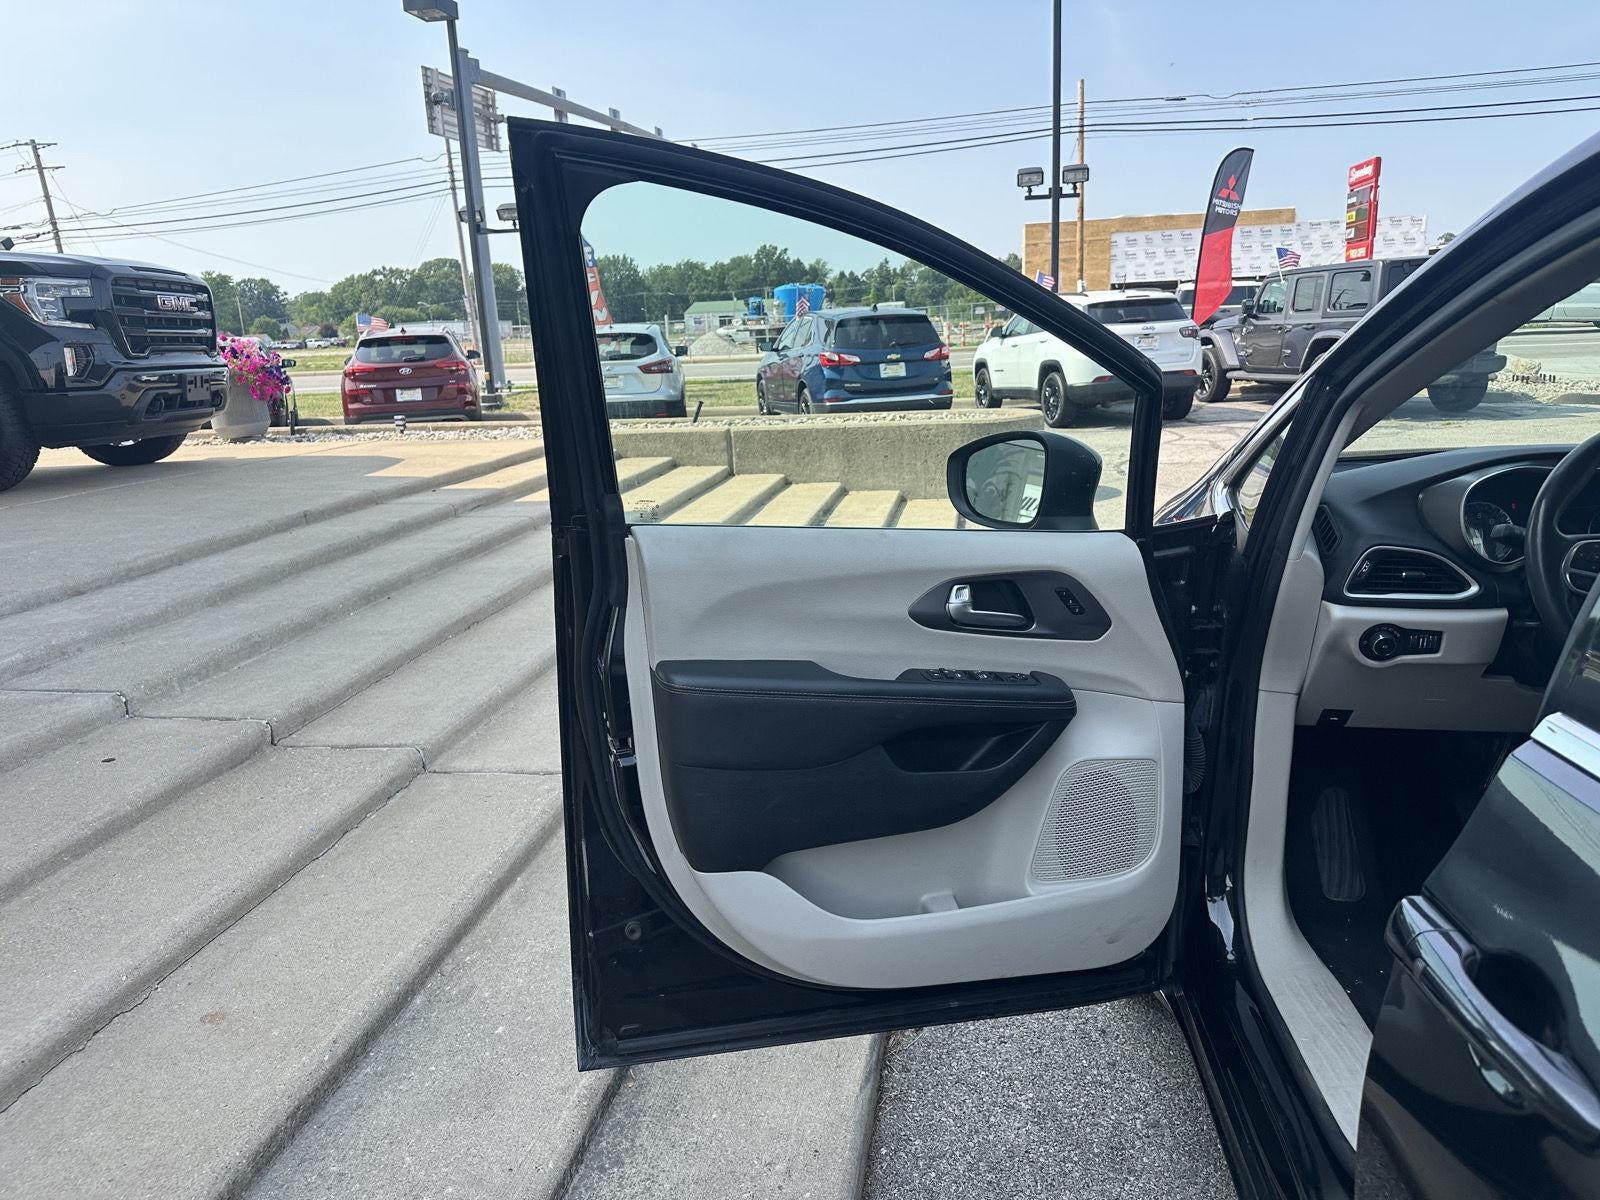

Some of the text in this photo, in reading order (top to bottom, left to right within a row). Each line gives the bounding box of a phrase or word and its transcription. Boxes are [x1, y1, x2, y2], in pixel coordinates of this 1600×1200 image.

[1212, 198, 1241, 209] MITSUBISH
[1215, 206, 1238, 216] MOTORS
[157, 294, 198, 311] GMC
